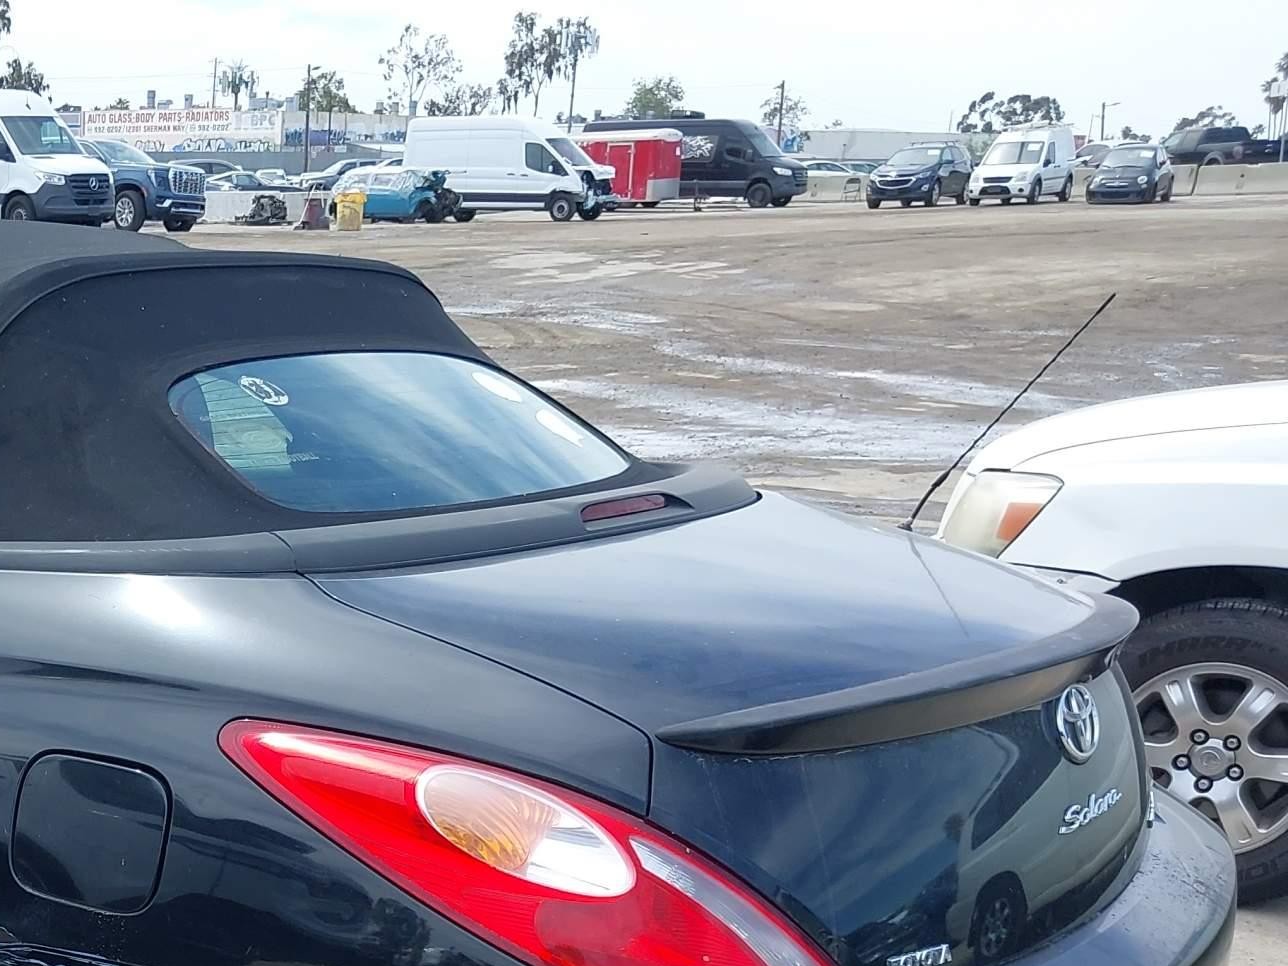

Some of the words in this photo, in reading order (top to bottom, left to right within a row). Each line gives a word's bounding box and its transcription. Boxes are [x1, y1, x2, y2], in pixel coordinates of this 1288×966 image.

[87, 113, 107, 124] AUTO
[143, 124, 171, 133] SHERMAN
[1058, 788, 1122, 834] Solara
